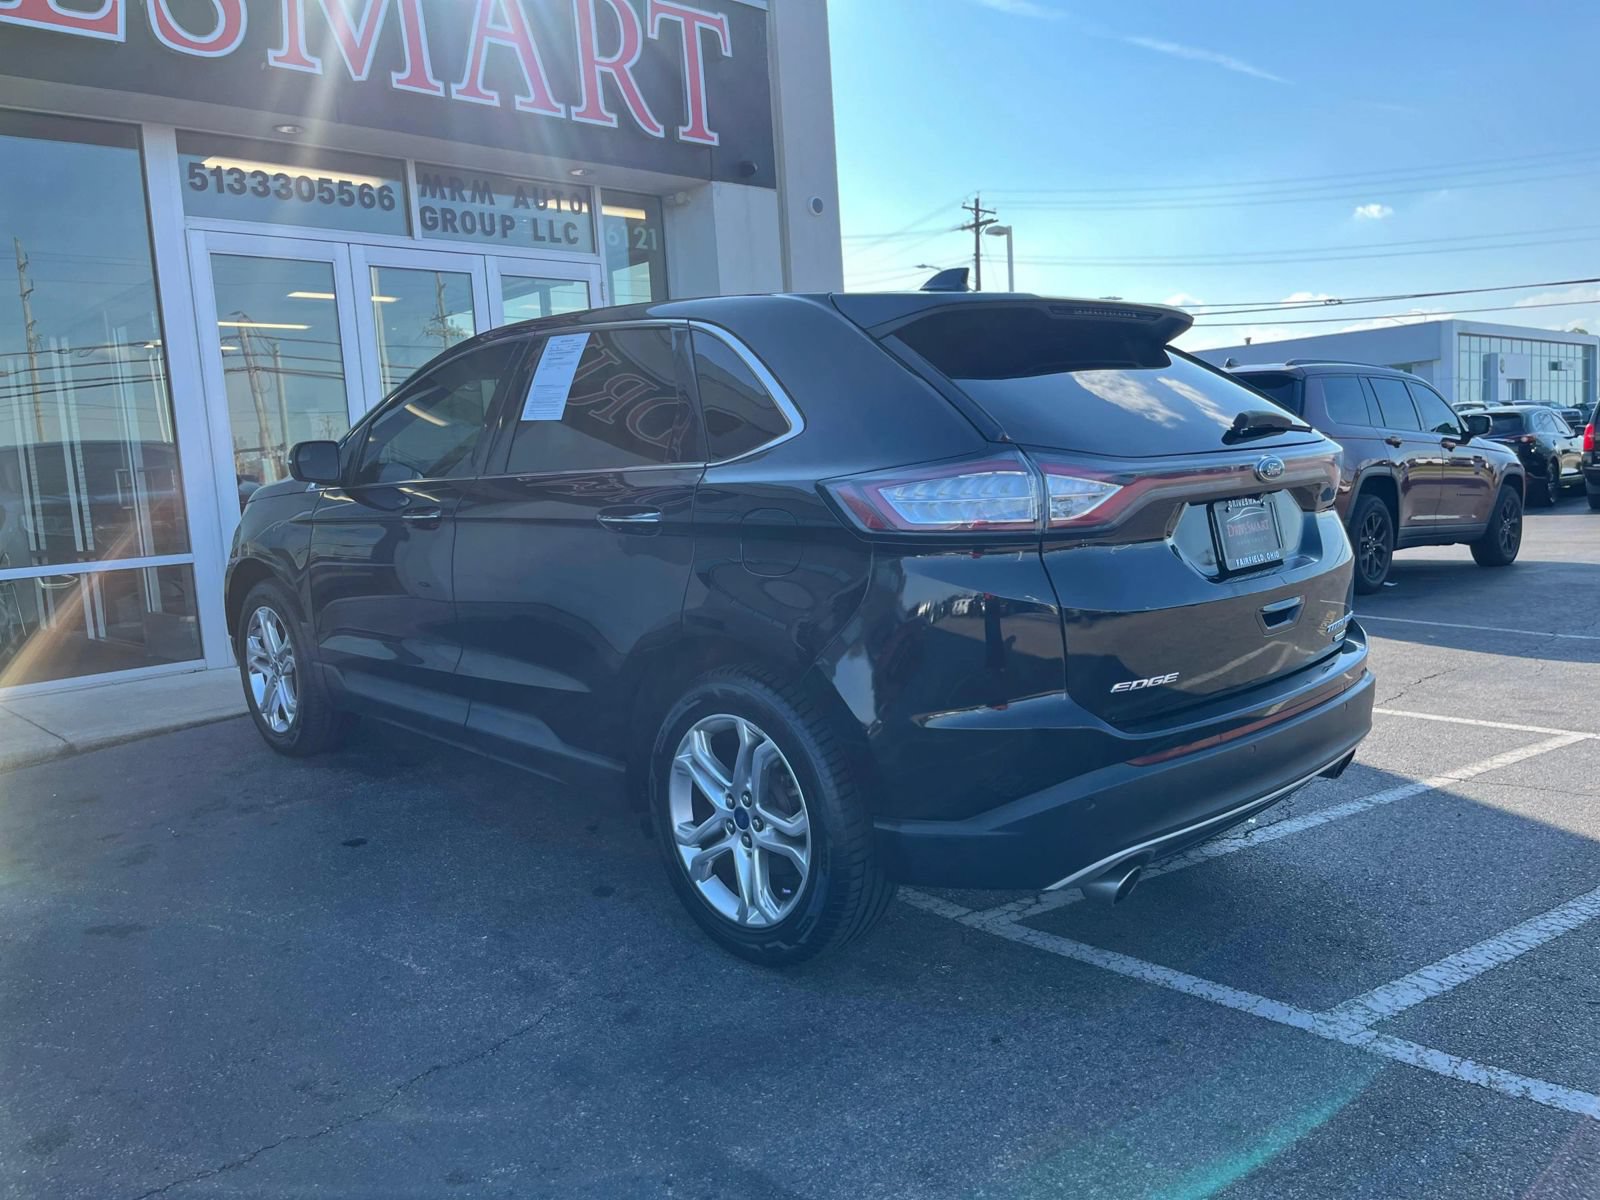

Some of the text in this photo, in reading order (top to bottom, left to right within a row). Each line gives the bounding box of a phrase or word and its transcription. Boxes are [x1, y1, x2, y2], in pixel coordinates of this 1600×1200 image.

[0, 0, 733, 146] MART
[188, 162, 396, 212] 5133305566
[419, 173, 583, 215] MRM AUTO
[419, 205, 579, 245] GROUP LLC
[1110, 672, 1180, 693] EDGE
